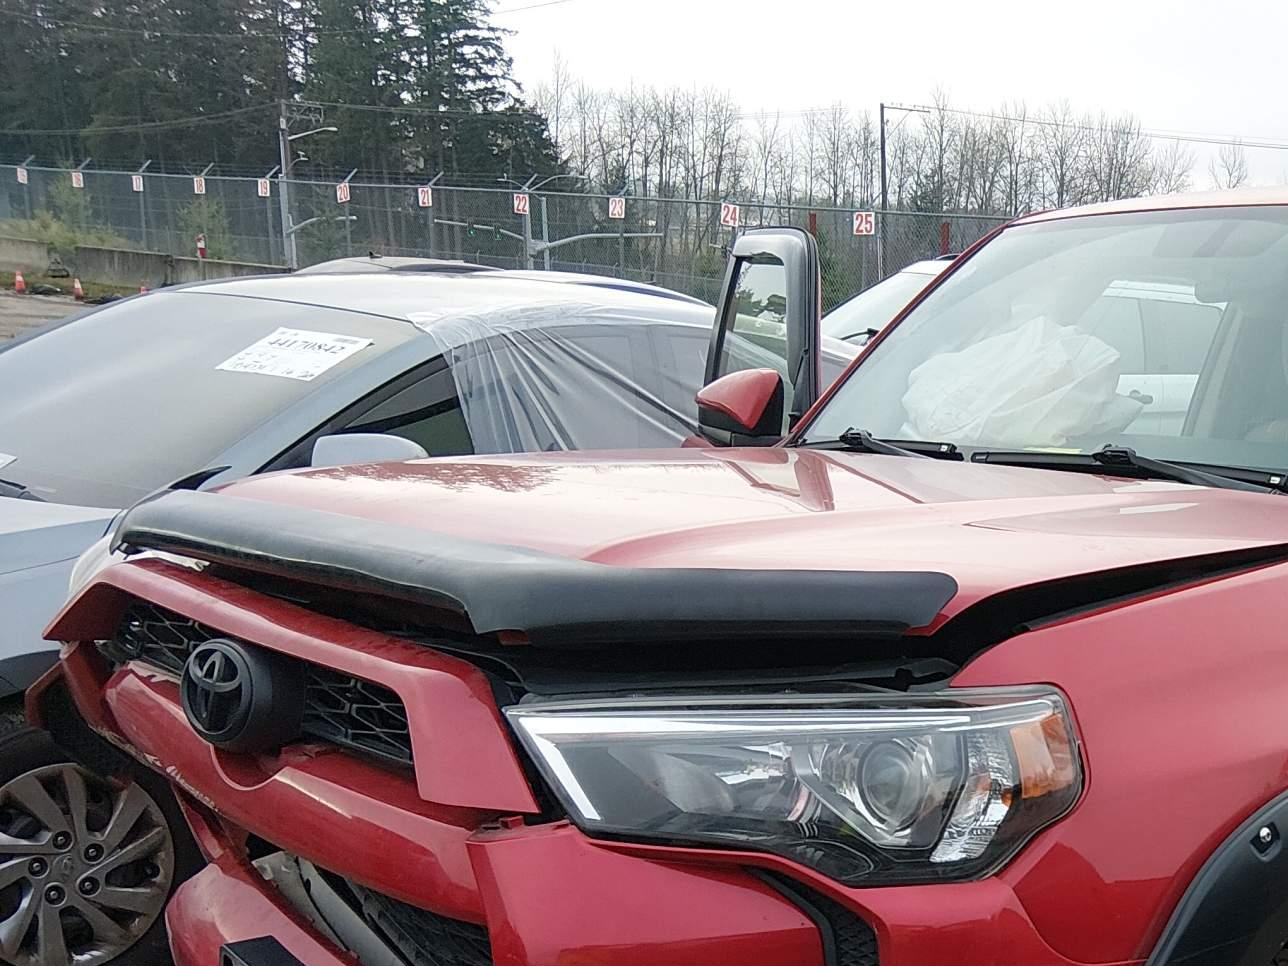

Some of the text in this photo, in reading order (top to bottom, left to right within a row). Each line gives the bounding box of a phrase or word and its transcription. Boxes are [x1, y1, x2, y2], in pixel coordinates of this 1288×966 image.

[195, 178, 204, 193] 18
[259, 180, 268, 195] 19
[338, 186, 349, 201] 20
[421, 188, 430, 205] 21
[516, 196, 528, 213] 22
[611, 199, 624, 217] 23
[723, 205, 738, 225] 24
[855, 213, 874, 234] 25
